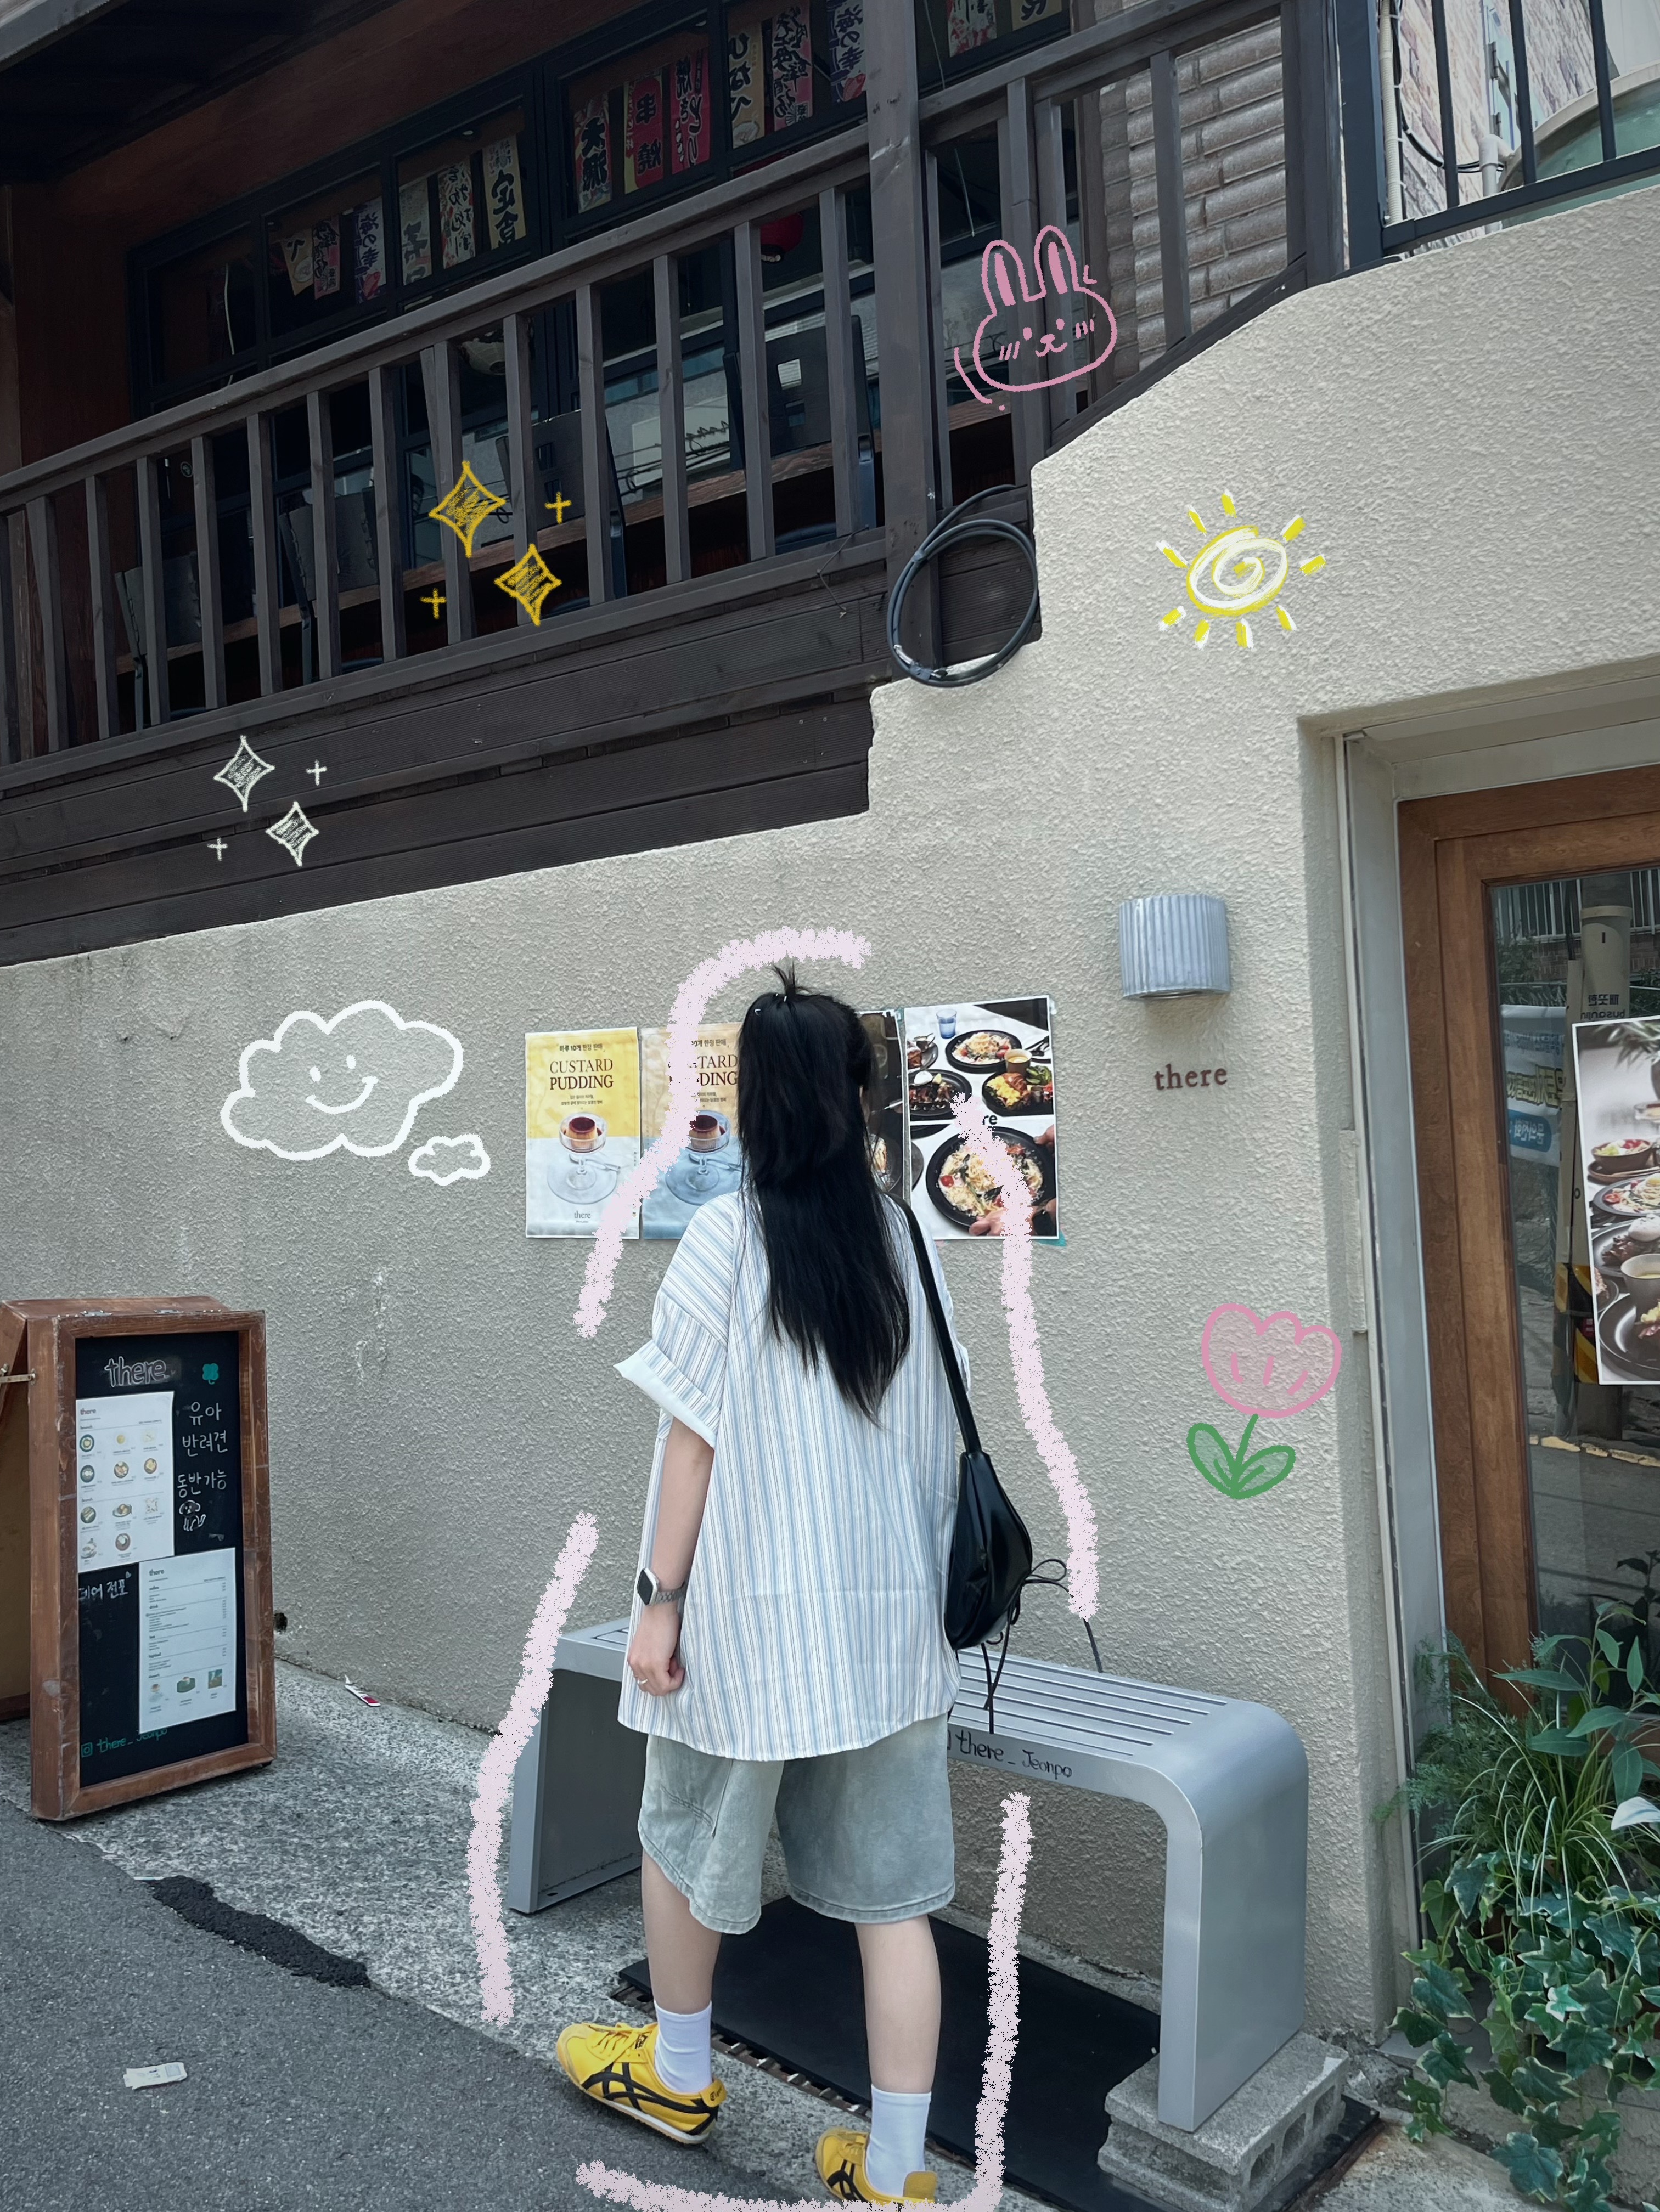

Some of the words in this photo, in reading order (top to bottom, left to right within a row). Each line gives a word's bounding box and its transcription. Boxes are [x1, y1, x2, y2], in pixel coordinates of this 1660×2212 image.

[550, 1058, 613, 1074] CUSTARD
[1154, 1063, 1228, 1091] there
[550, 1074, 614, 1090] PUDDING
[574, 1210, 591, 1219] there
[104, 1356, 166, 1387] there
[188, 1401, 222, 1426] 유아
[182, 1430, 229, 1457] 반려견
